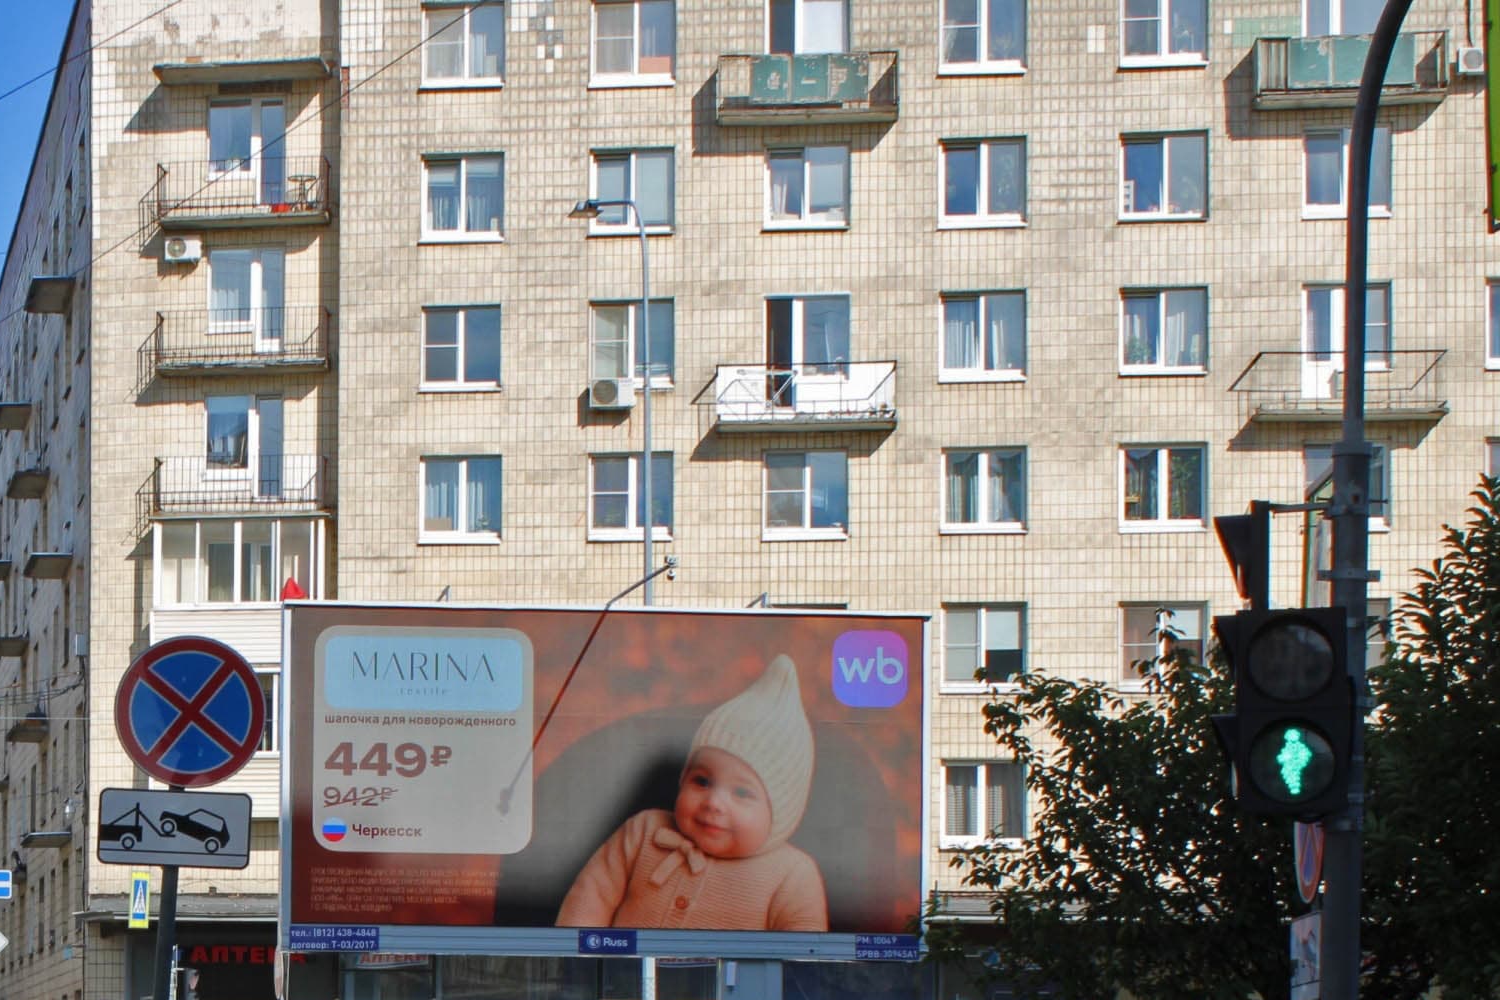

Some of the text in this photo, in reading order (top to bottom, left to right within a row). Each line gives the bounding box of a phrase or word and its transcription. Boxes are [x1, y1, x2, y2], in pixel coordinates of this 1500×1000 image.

[352, 651, 495, 682] MARINA
[837, 645, 904, 685] wb
[325, 714, 516, 728] шапочка для новорожденного
[352, 823, 422, 839] Черкесск
[603, 937, 628, 947] Russ
